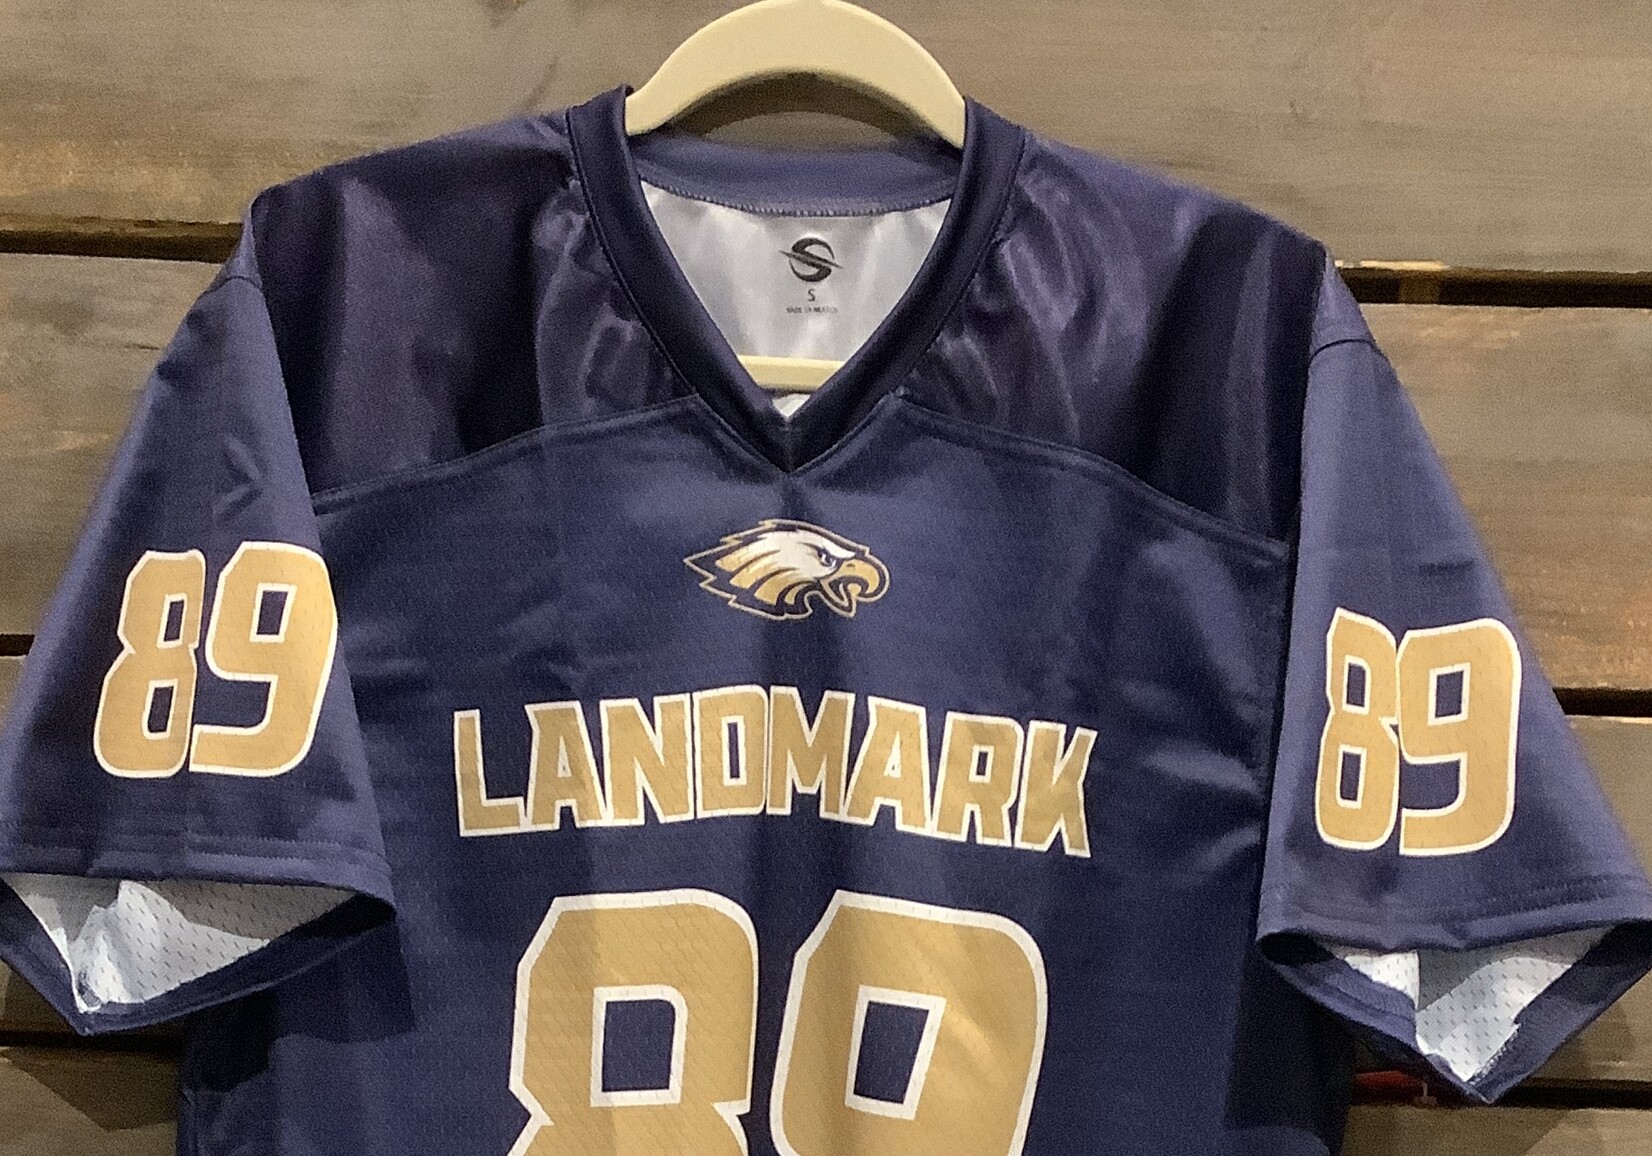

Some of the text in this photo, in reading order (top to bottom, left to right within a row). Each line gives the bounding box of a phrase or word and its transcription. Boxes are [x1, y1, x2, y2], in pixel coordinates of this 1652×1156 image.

[807, 288, 816, 302] S
[93, 541, 338, 778] 89
[1315, 607, 1522, 856] 89
[454, 684, 1098, 858] LANDMARK
